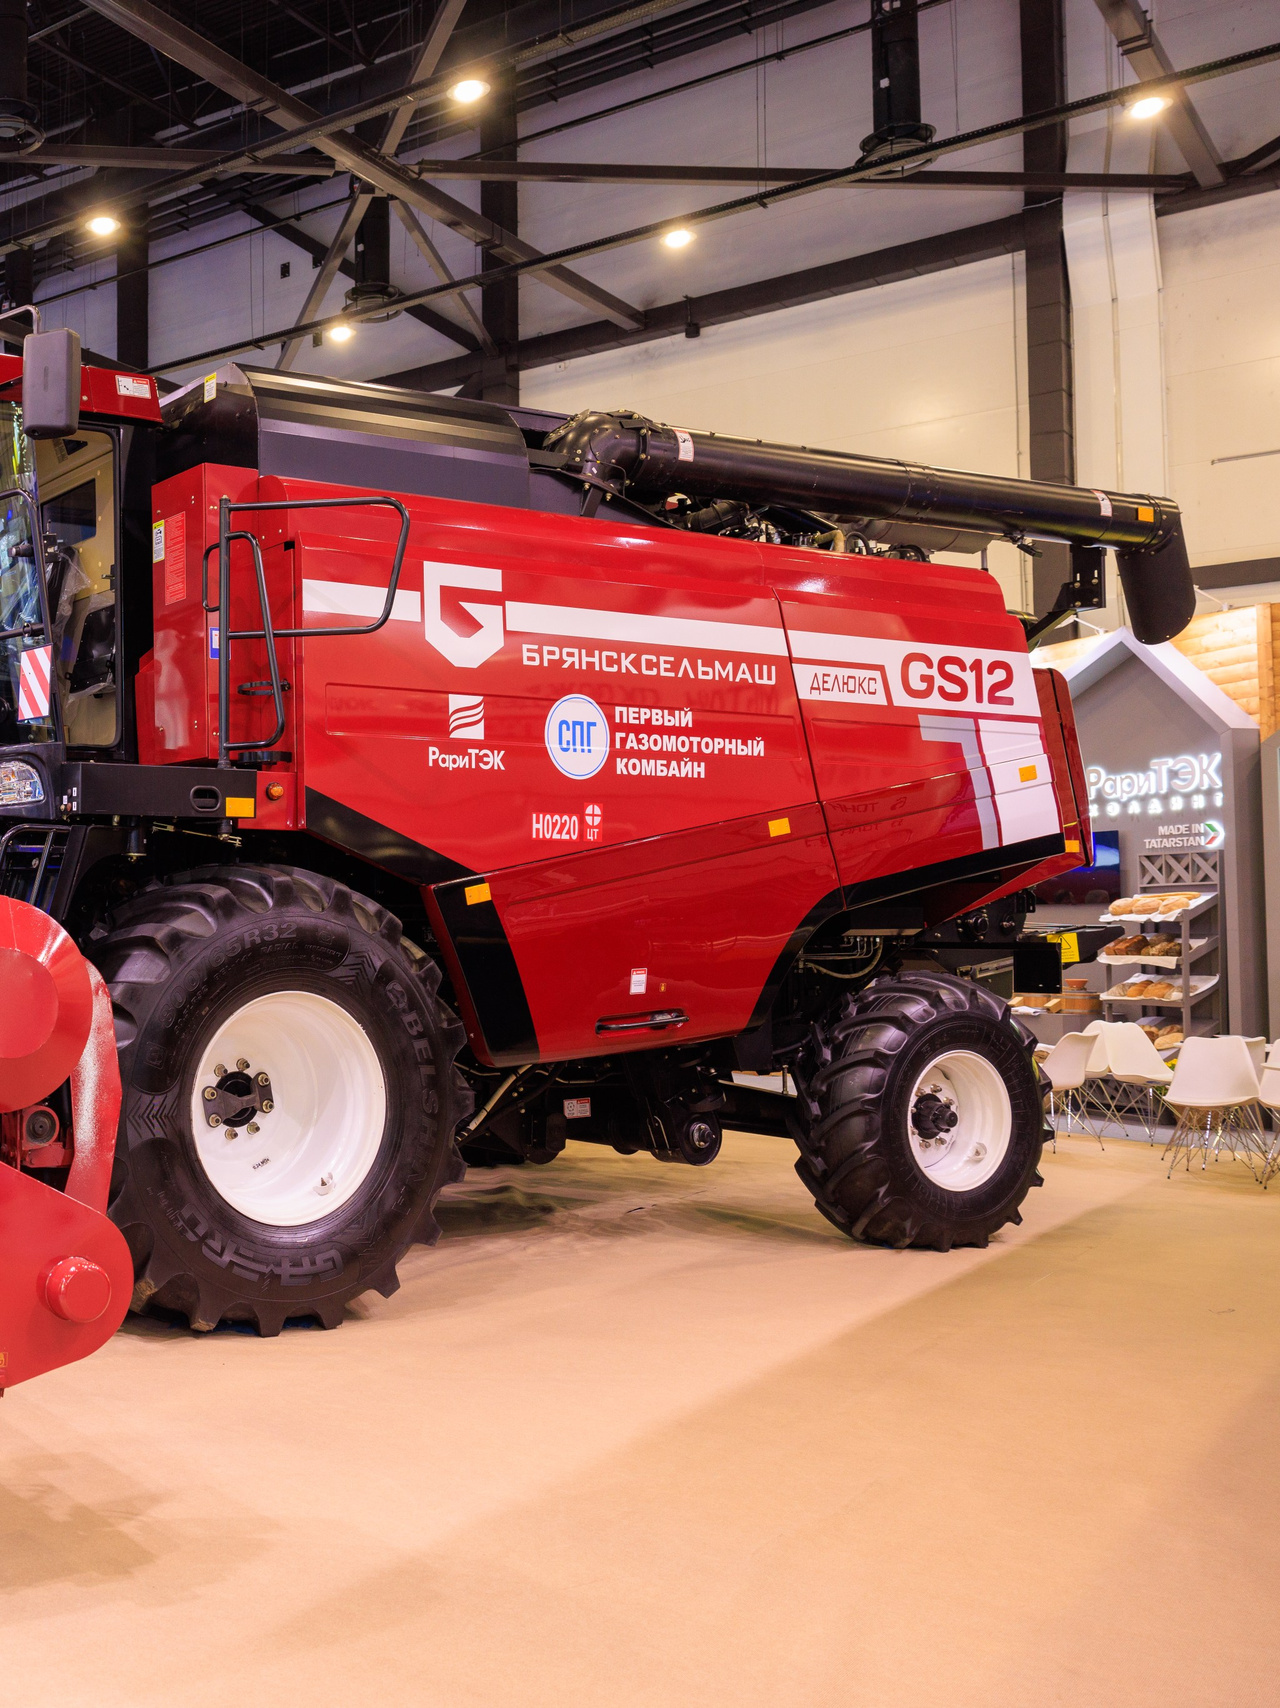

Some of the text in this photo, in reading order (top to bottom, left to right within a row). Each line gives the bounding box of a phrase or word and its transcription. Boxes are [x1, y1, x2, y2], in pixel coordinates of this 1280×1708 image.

[522, 643, 777, 686] БРЯНСКСЕЛЬМАШ
[809, 671, 877, 696] ДЕЛЮКС
[900, 652, 1015, 706] GS12
[614, 706, 693, 728] ПЕРВЫЙ
[558, 719, 597, 753] СПГ
[615, 732, 765, 757] ГАЗОМОТОРНЫЙ
[428, 746, 506, 771] РариТЭК
[616, 757, 705, 778] КОМБАЙН
[1085, 752, 1222, 801] РариТЭК
[586, 828, 599, 841] ЦТ
[1158, 823, 1204, 836] MADE IN
[1144, 836, 1205, 849] TATARSTAN
